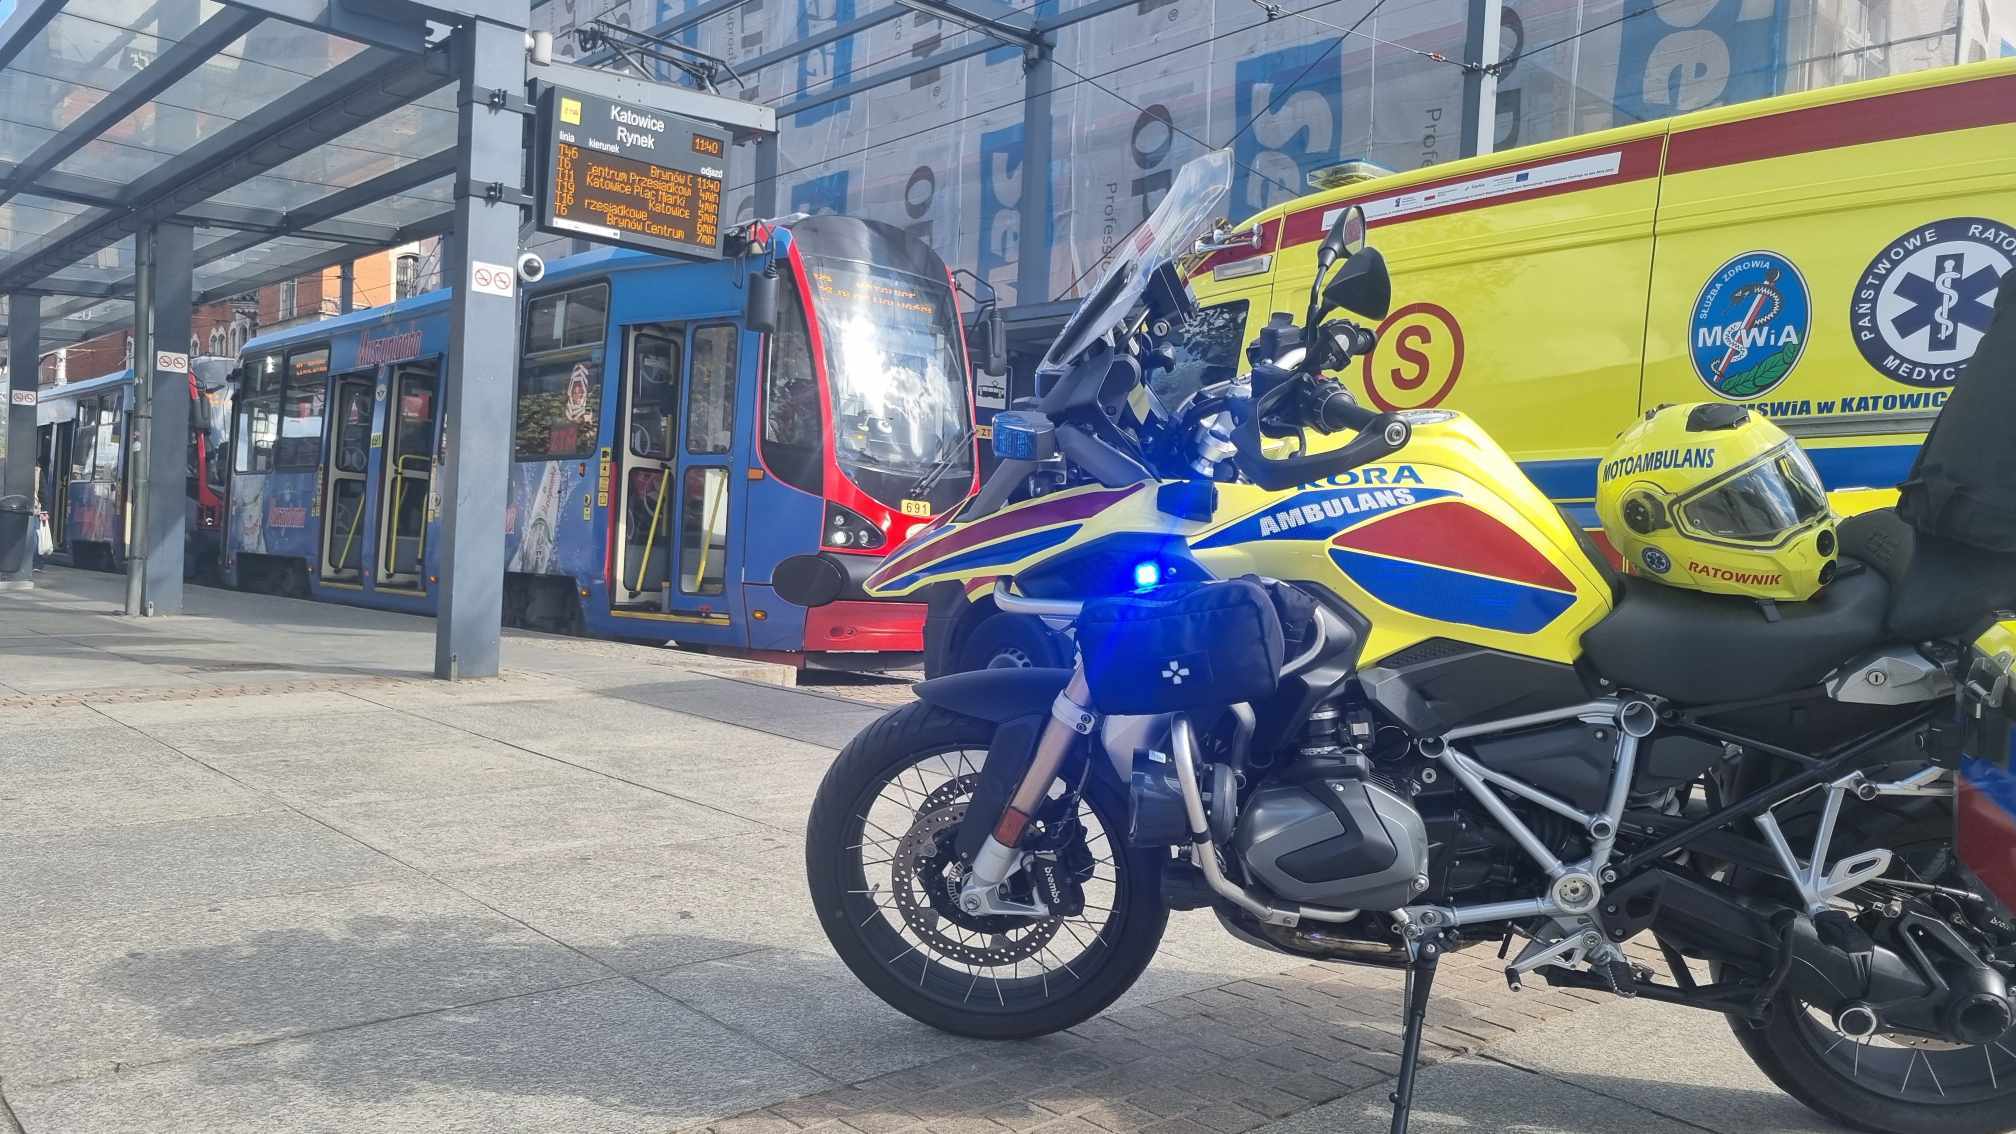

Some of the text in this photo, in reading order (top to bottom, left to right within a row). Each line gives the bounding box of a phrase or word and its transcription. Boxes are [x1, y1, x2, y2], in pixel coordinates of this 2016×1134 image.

[610, 104, 665, 132] Katowice
[559, 131, 575, 143] linia
[589, 138, 620, 153] kierunek
[617, 126, 655, 149] Rynek
[695, 138, 718, 154] 11:40
[557, 167, 574, 181] T11
[586, 173, 632, 195] Katowice
[558, 156, 571, 169] T6
[587, 162, 627, 183] entrum
[559, 144, 578, 159] T46
[697, 177, 720, 192] 11:40
[701, 167, 723, 178] odjazd
[556, 180, 575, 193] T19
[554, 203, 568, 216] T6
[607, 212, 642, 231] Brynów
[645, 220, 685, 240] Centrum
[696, 233, 716, 247] 7min
[555, 191, 574, 205] T16
[697, 221, 716, 236] 6min
[1722, 260, 1770, 282] ZDROWIA
[1857, 224, 2016, 342] PAŃSTWOWE RATO
[1391, 325, 1432, 390] S
[1883, 354, 1967, 382] MEDYC
[1816, 401, 1836, 415] w
[1603, 448, 1715, 483] MOTOAMBULANS
[906, 502, 928, 513] 691
[1259, 488, 1416, 537] AMBULANS
[1688, 561, 1783, 586] RATOWNIK
[1045, 866, 1060, 904] brembo
